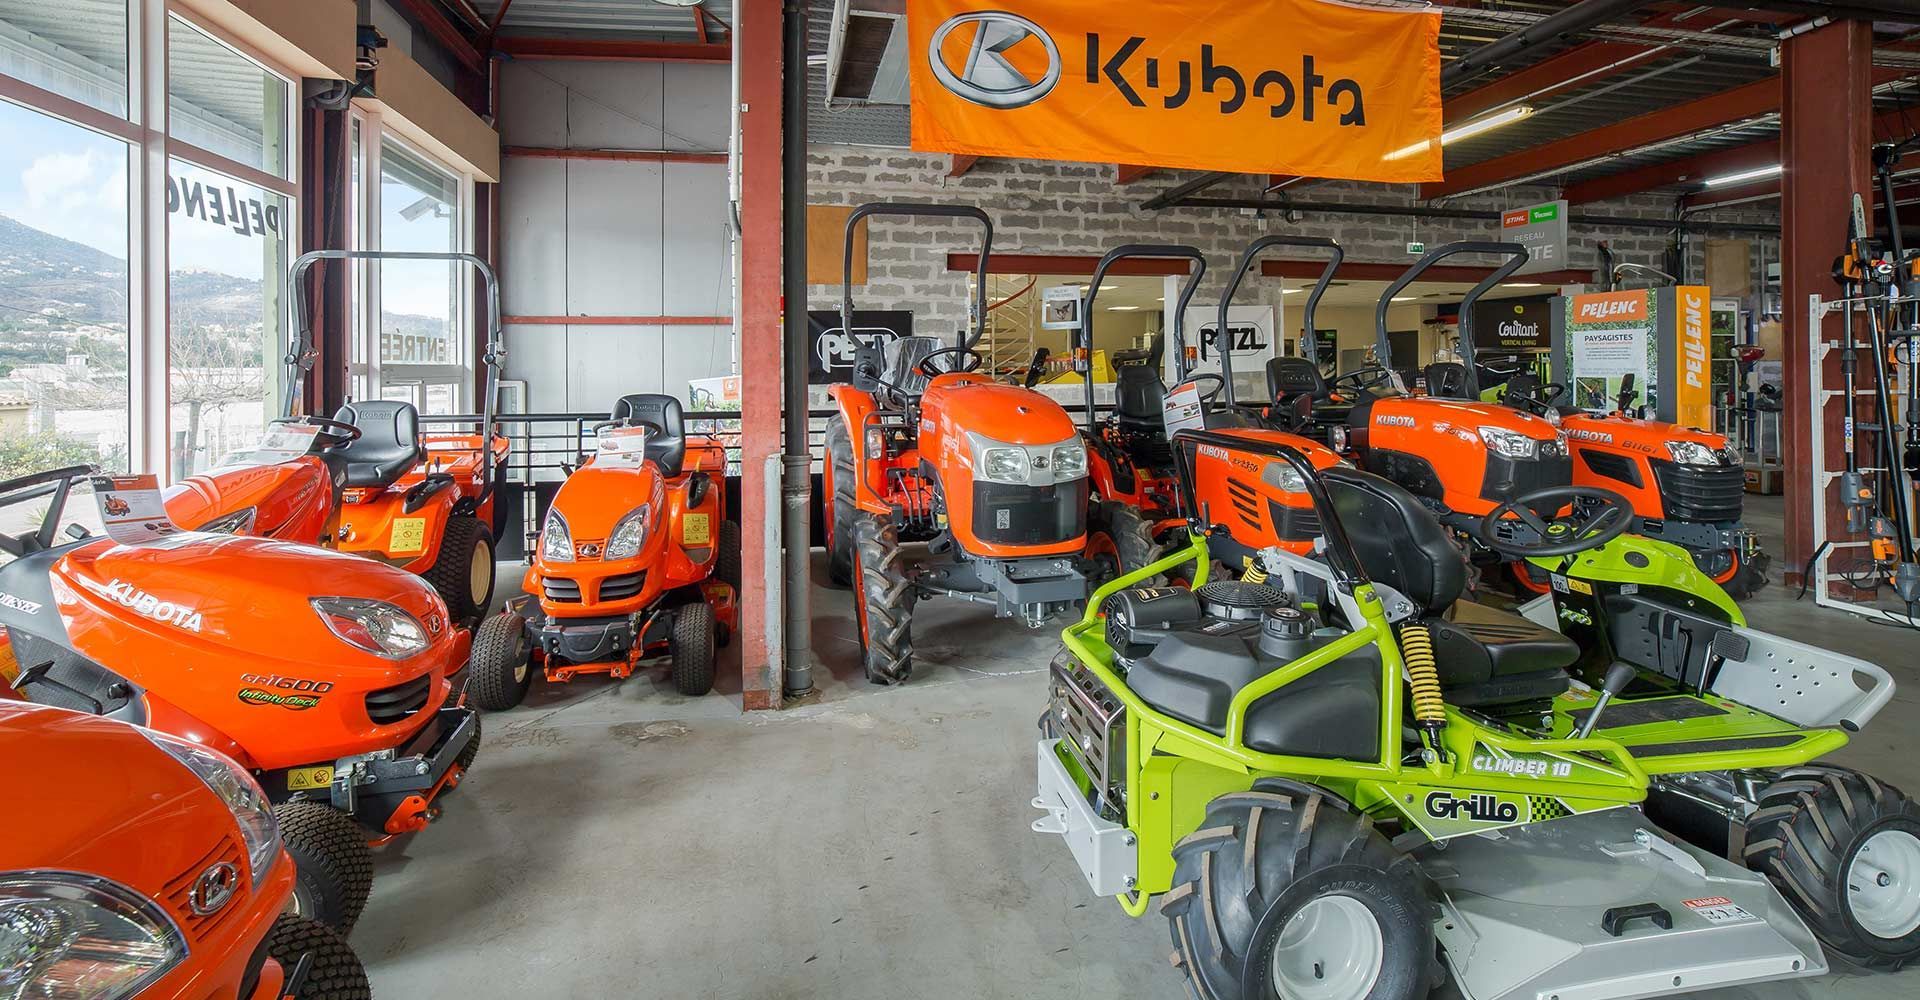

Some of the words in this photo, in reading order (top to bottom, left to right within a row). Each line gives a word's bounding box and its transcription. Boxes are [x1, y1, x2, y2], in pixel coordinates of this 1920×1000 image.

[1086, 32, 1366, 126] Kubota
[1505, 215, 1526, 225] STIHL
[1581, 300, 1638, 318] PELLENC
[1498, 320, 1540, 337] Courant
[1584, 333, 1634, 342] PAYSAGISTES
[1200, 327, 1268, 362] PTZL
[1685, 293, 1706, 389] PELLENC
[1375, 414, 1416, 428] KUBOTA
[1564, 427, 1614, 444] KUBOTA
[1198, 443, 1230, 462] KUBOTA
[106, 577, 203, 633] KUBOTA
[239, 689, 285, 705] Infinity
[285, 695, 320, 707] Deck
[1472, 755, 1548, 775] CLIMBER
[1552, 761, 1573, 777] 10
[1425, 791, 1518, 823] Grillo
